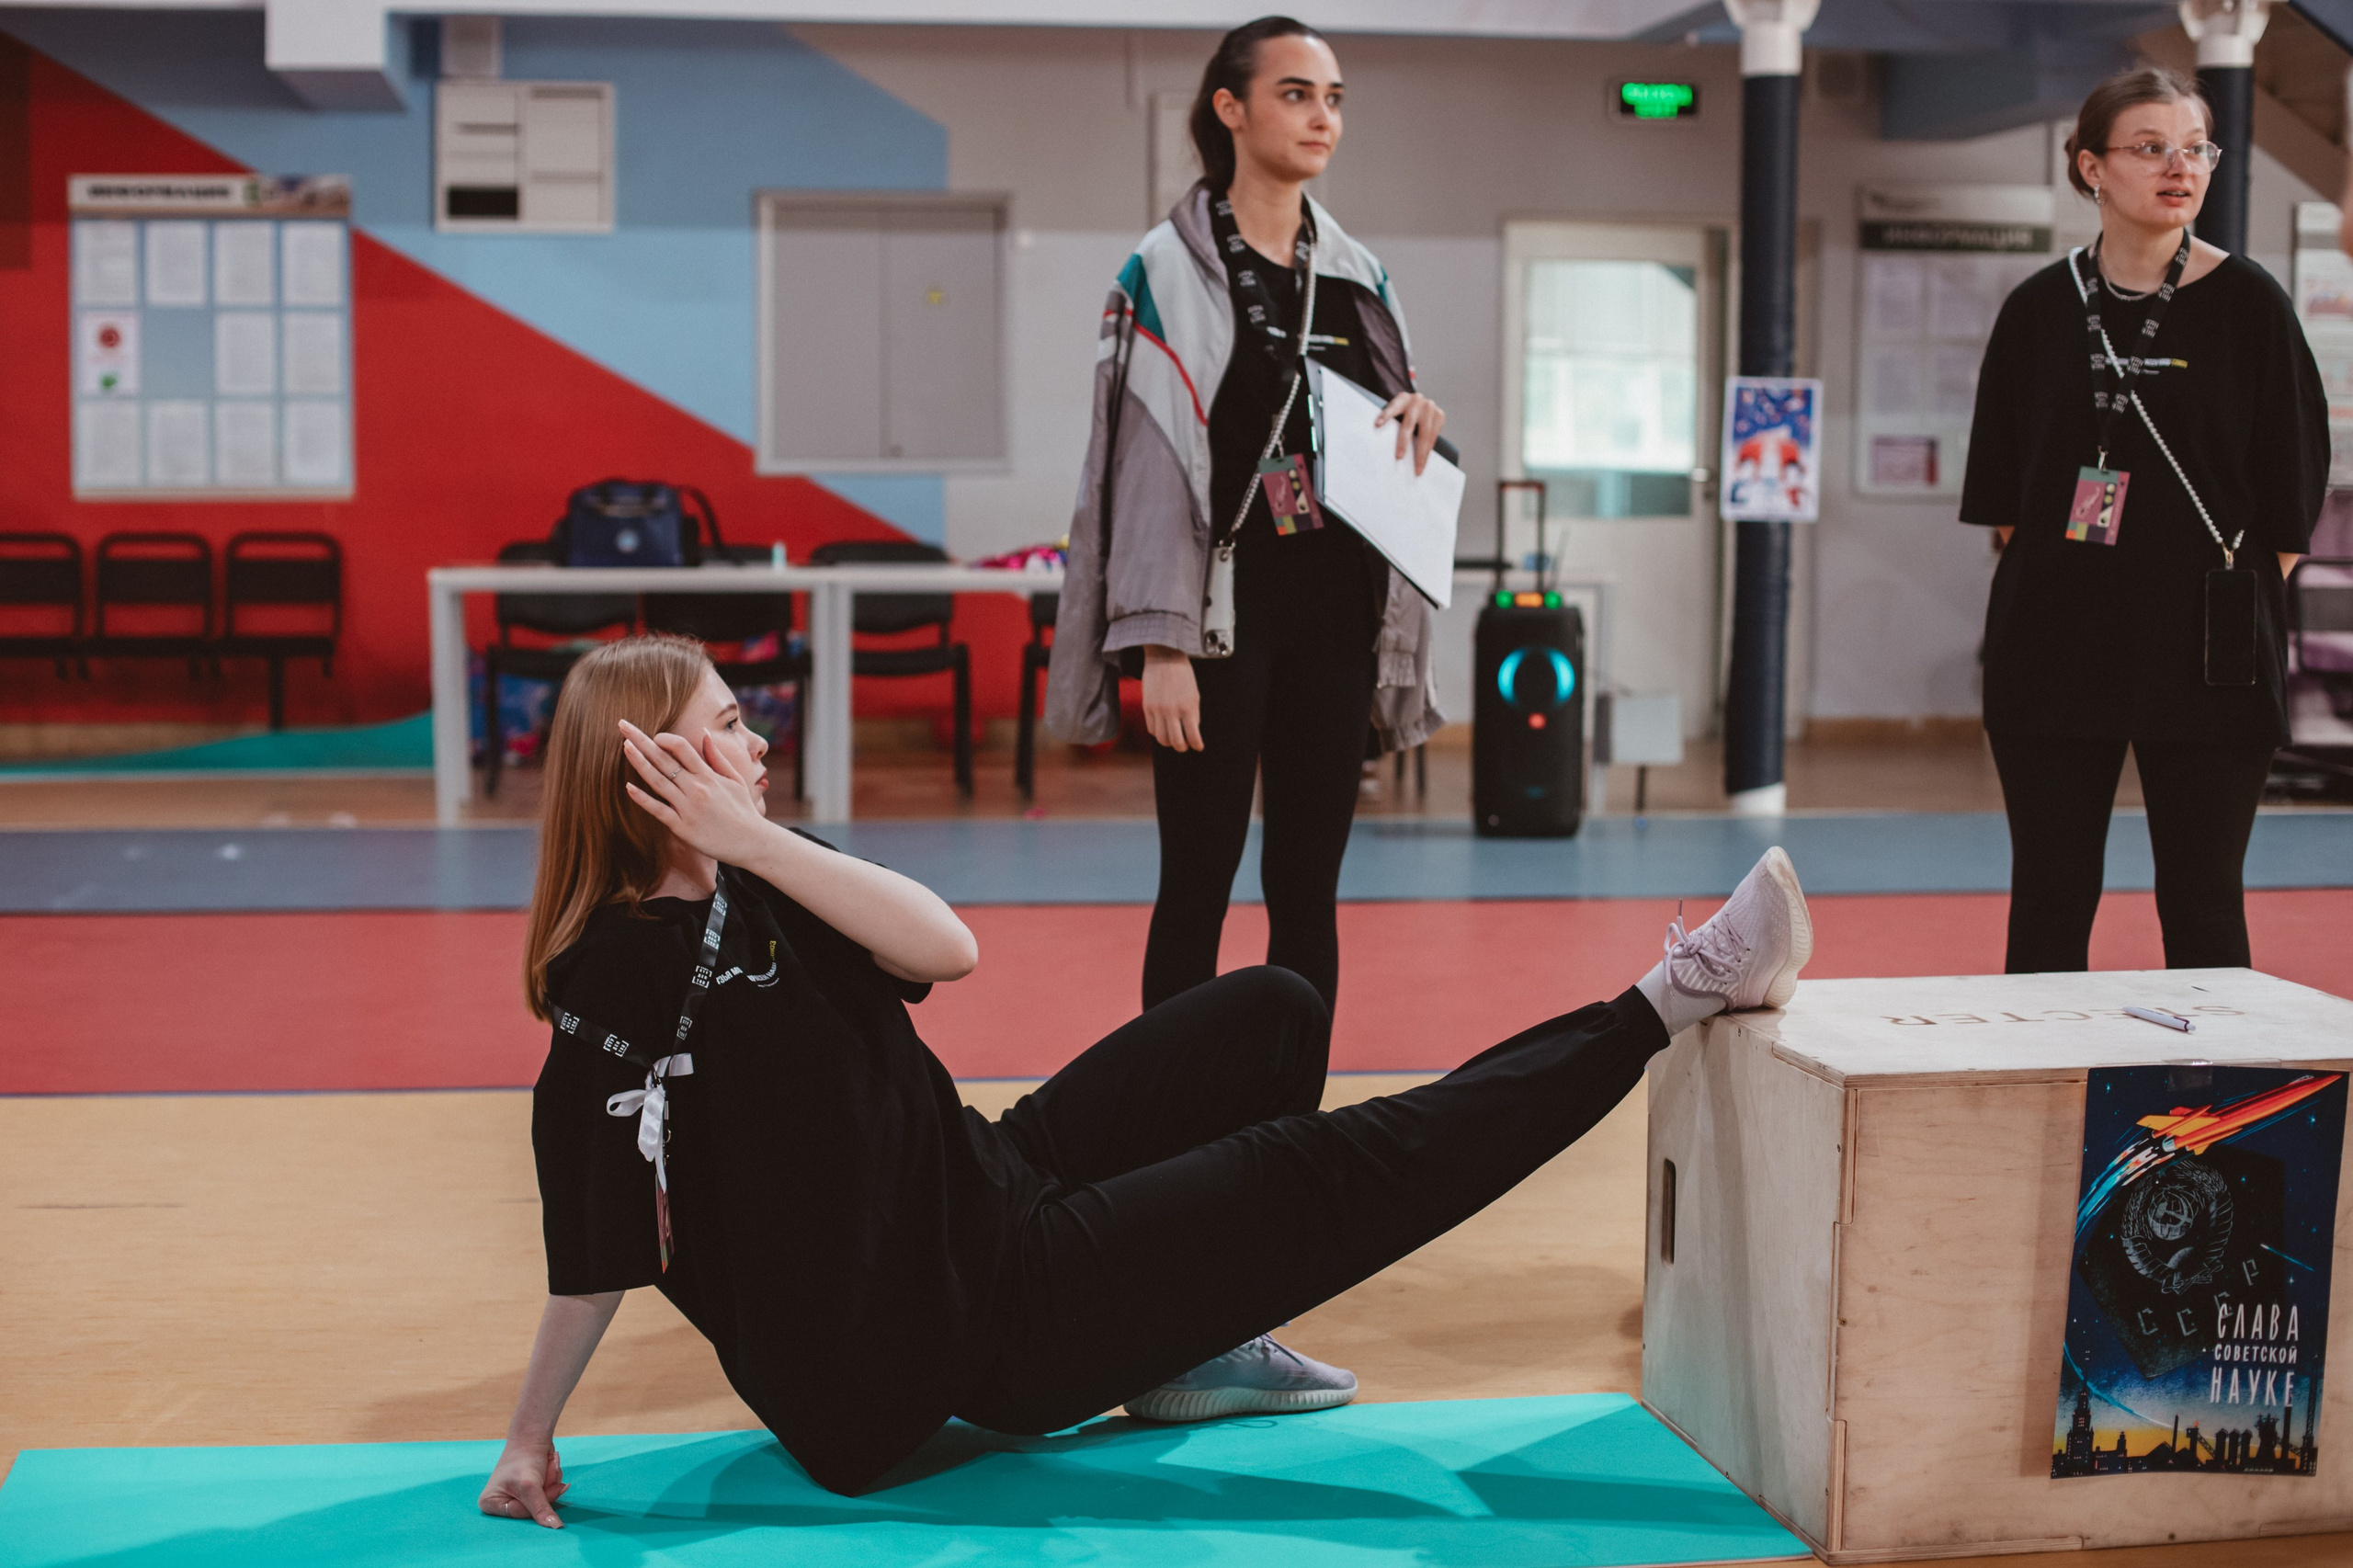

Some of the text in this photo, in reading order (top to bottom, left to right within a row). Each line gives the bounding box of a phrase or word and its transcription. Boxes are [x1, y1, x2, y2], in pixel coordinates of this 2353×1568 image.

[2217, 1303, 2299, 1341] СЛАВА
[2214, 1344, 2298, 1364] СОВЕТСКОЙ
[2210, 1367, 2295, 1407] НАУКЕ
